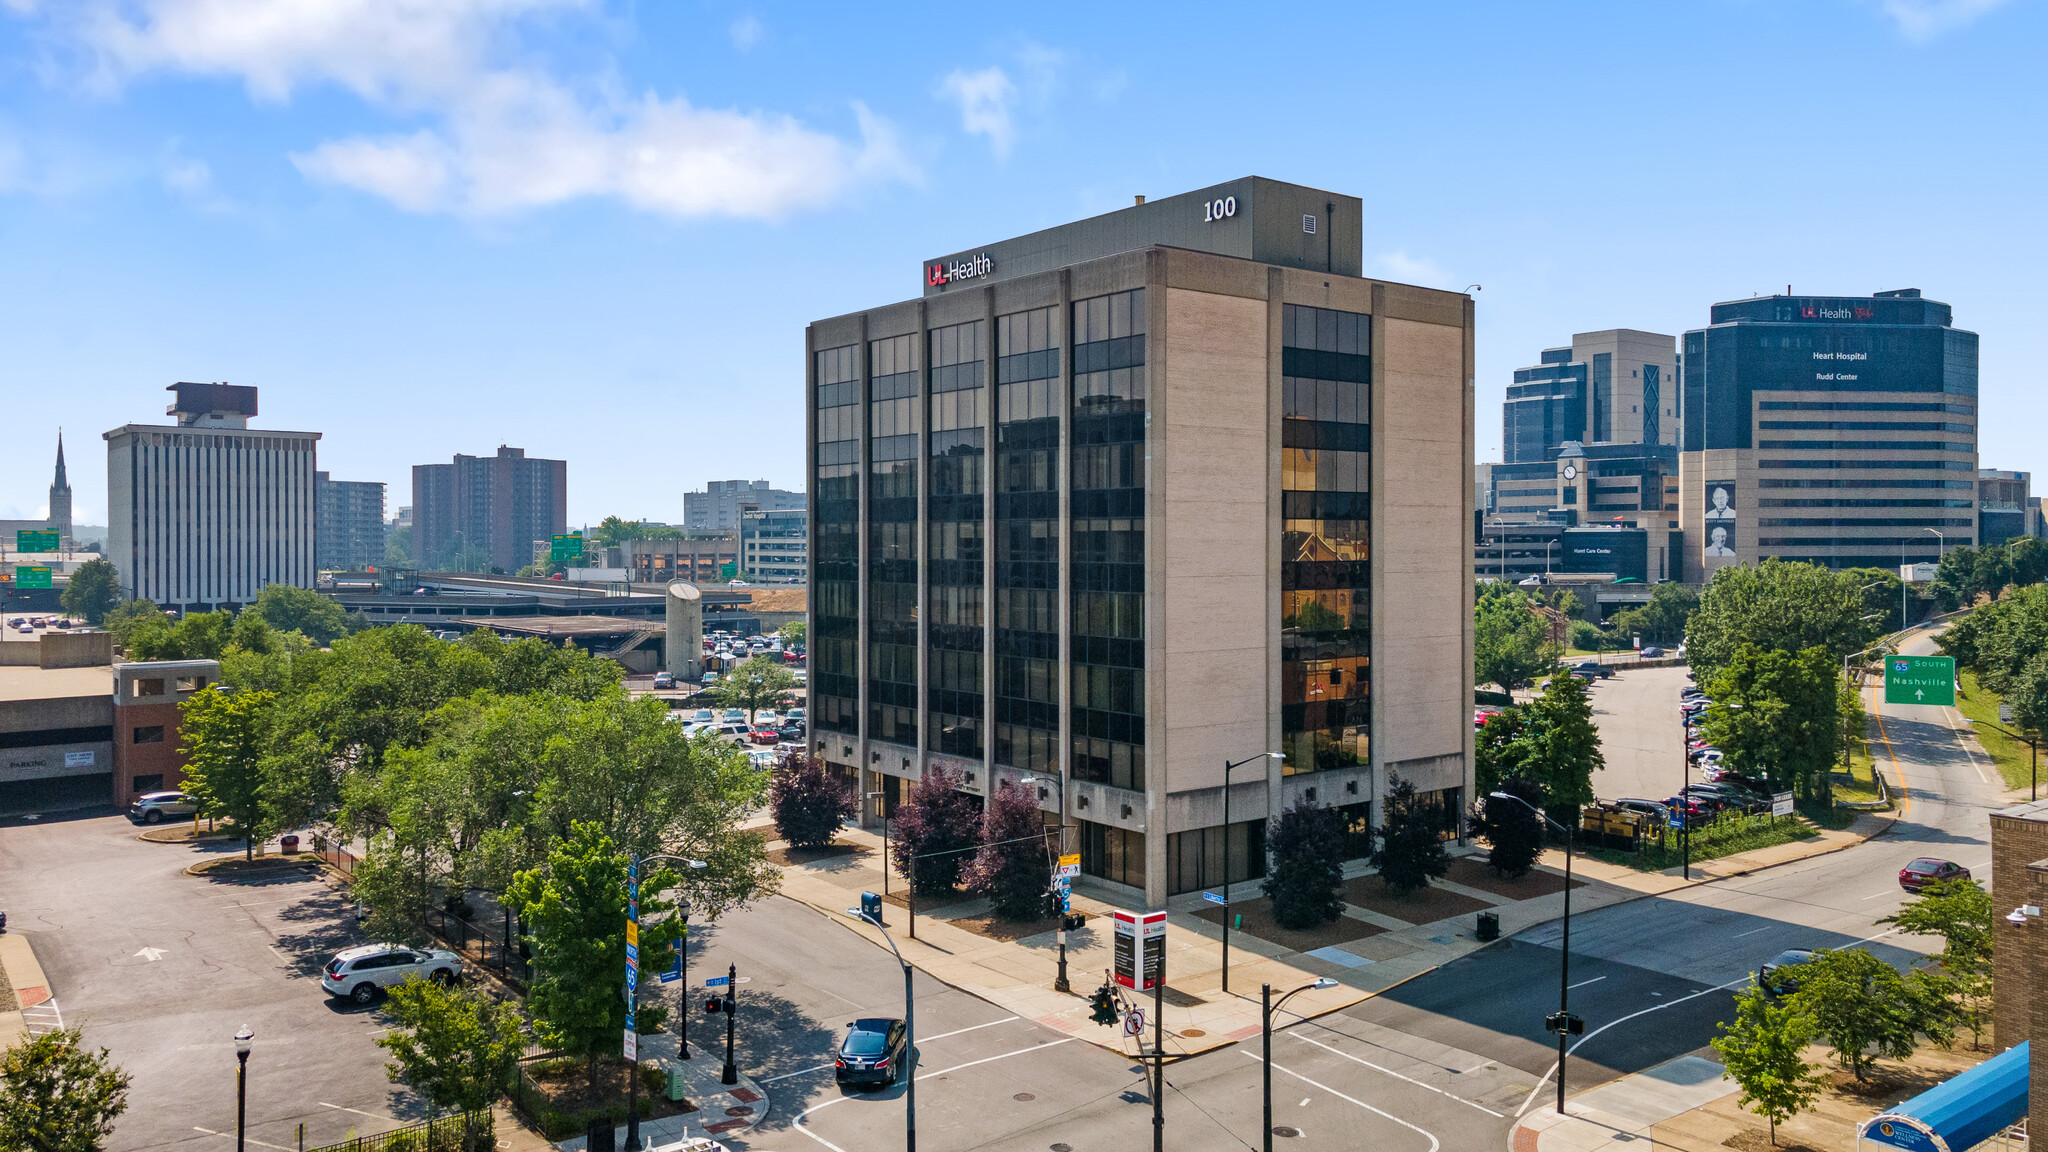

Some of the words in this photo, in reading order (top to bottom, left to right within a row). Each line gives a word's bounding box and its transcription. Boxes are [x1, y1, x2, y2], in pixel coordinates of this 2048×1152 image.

[1204, 196, 1236, 222] 100
[949, 252, 991, 282] Health
[1819, 308, 1851, 319] Health
[1813, 352, 1834, 360] Heart
[1836, 352, 1867, 361] Hospital
[1893, 677, 1946, 687] Nashville
[10, 760, 47, 769] PARKING
[1121, 925, 1135, 934] Health
[1151, 925, 1166, 933] Health
[627, 968, 636, 986] 65
[1894, 1135, 1915, 1145] CENTER
[1895, 1131, 1921, 1142] WELLNESS
